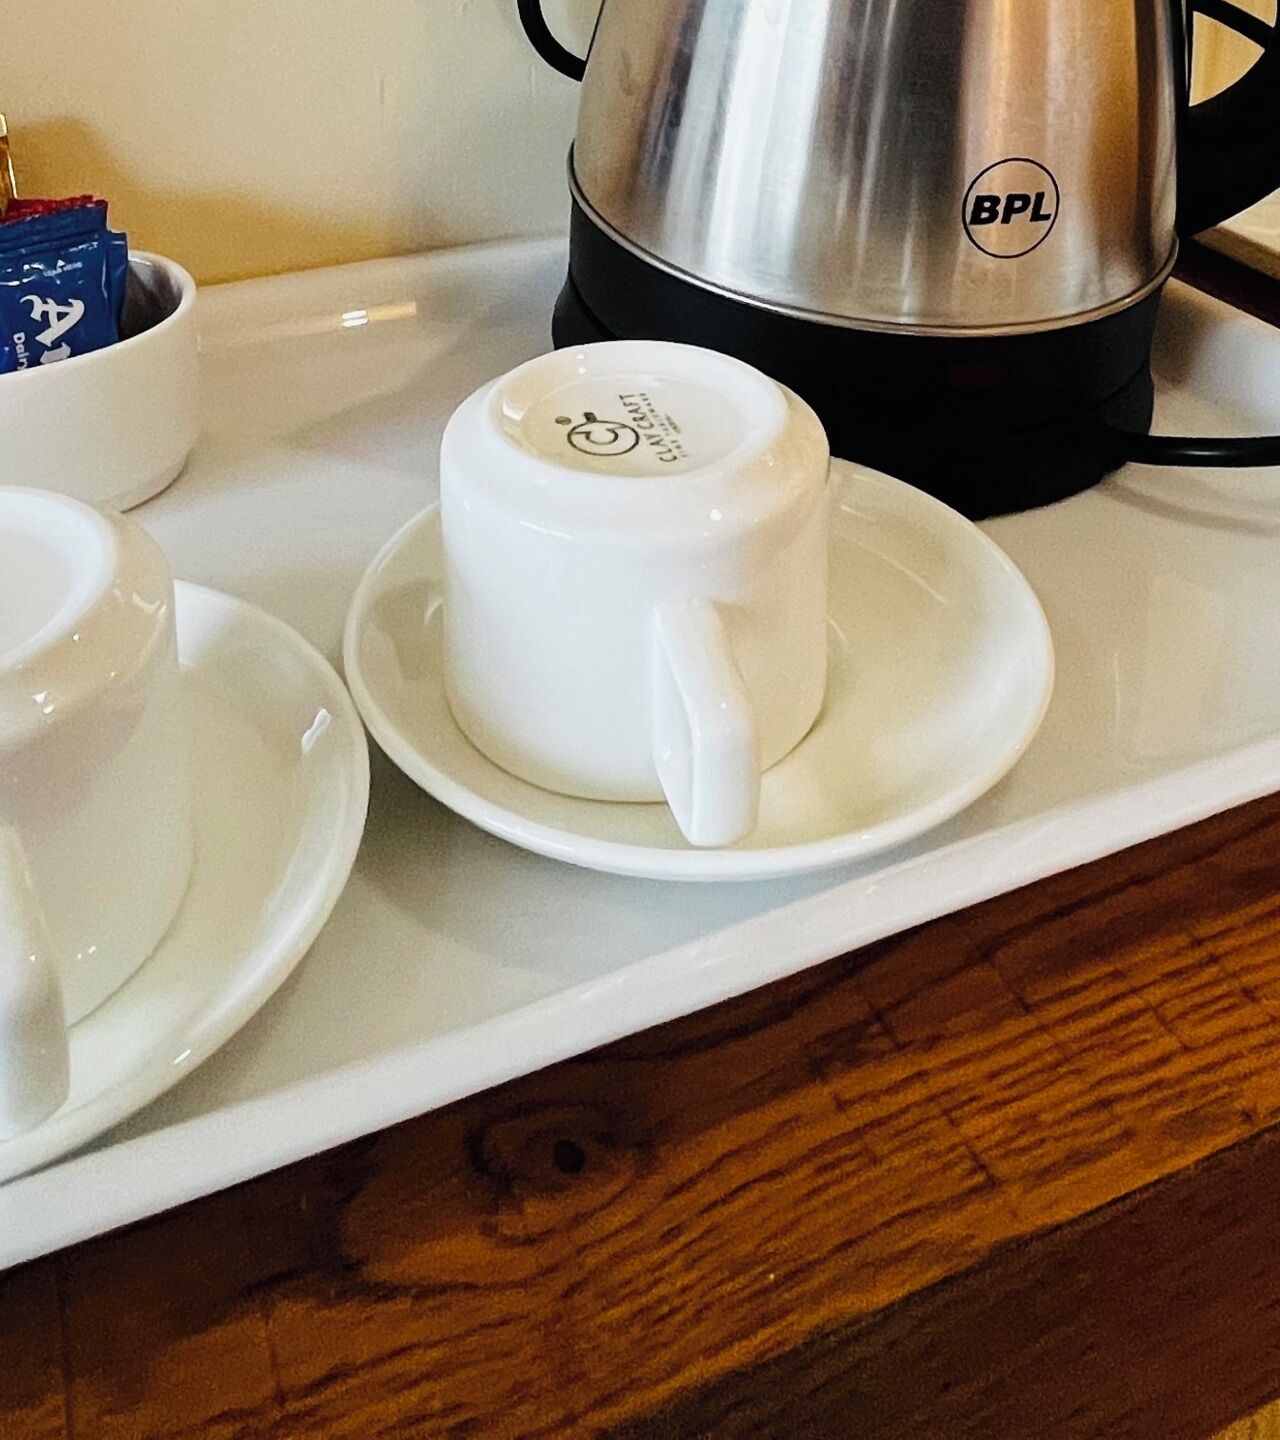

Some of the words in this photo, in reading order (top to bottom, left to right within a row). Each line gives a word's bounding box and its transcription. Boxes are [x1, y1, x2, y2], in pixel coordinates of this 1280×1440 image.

[969, 191, 1051, 225] BPL
[619, 394, 655, 429] CRAFT
[643, 433, 678, 462] CLAY
